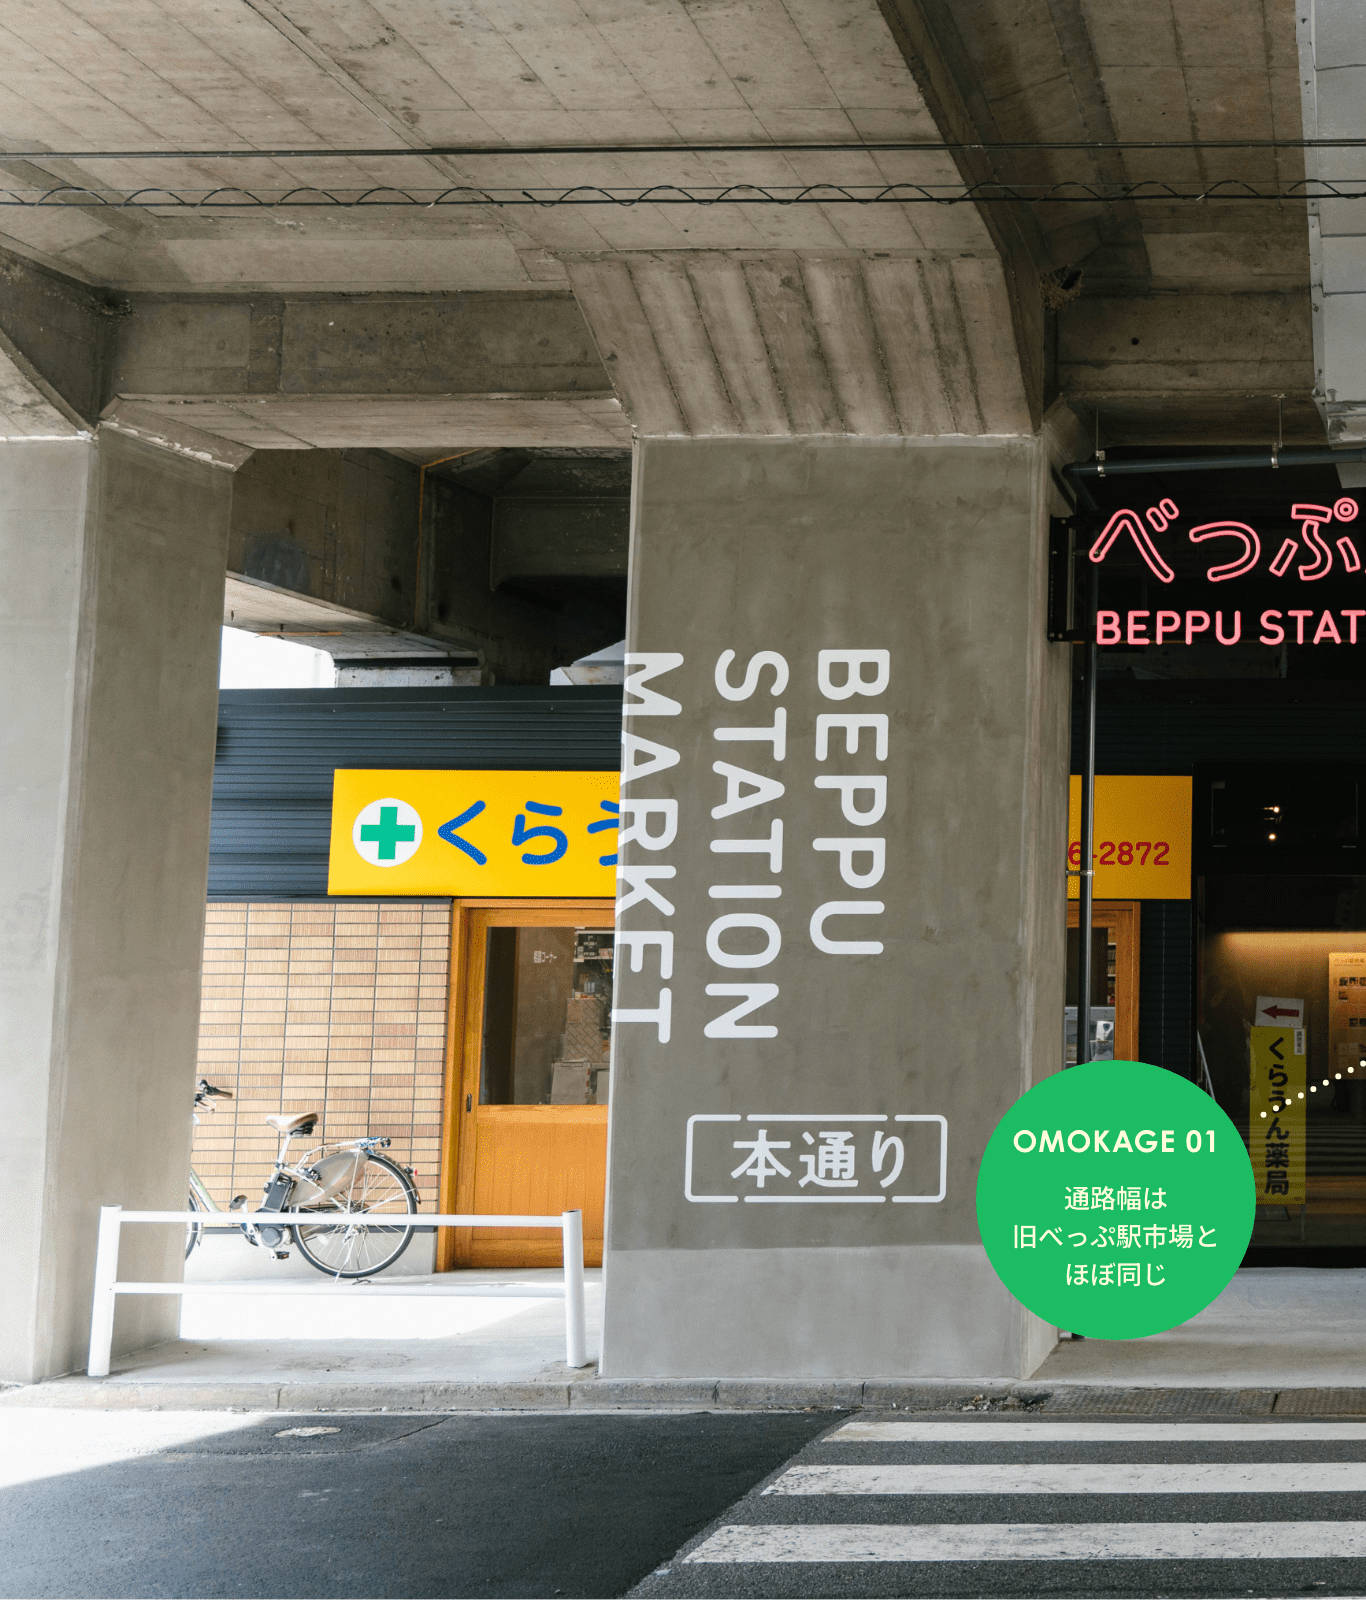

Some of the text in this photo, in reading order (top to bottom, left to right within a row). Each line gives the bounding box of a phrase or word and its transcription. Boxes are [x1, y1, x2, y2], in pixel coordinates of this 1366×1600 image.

[1096, 610, 1241, 646] BEPPU
[612, 652, 684, 1044] MARKET
[703, 649, 789, 1038] STATION
[809, 649, 890, 955] BEPPU
[730, 1129, 905, 1188] 本通り
[1264, 1036, 1290, 1196] くらうん薬局
